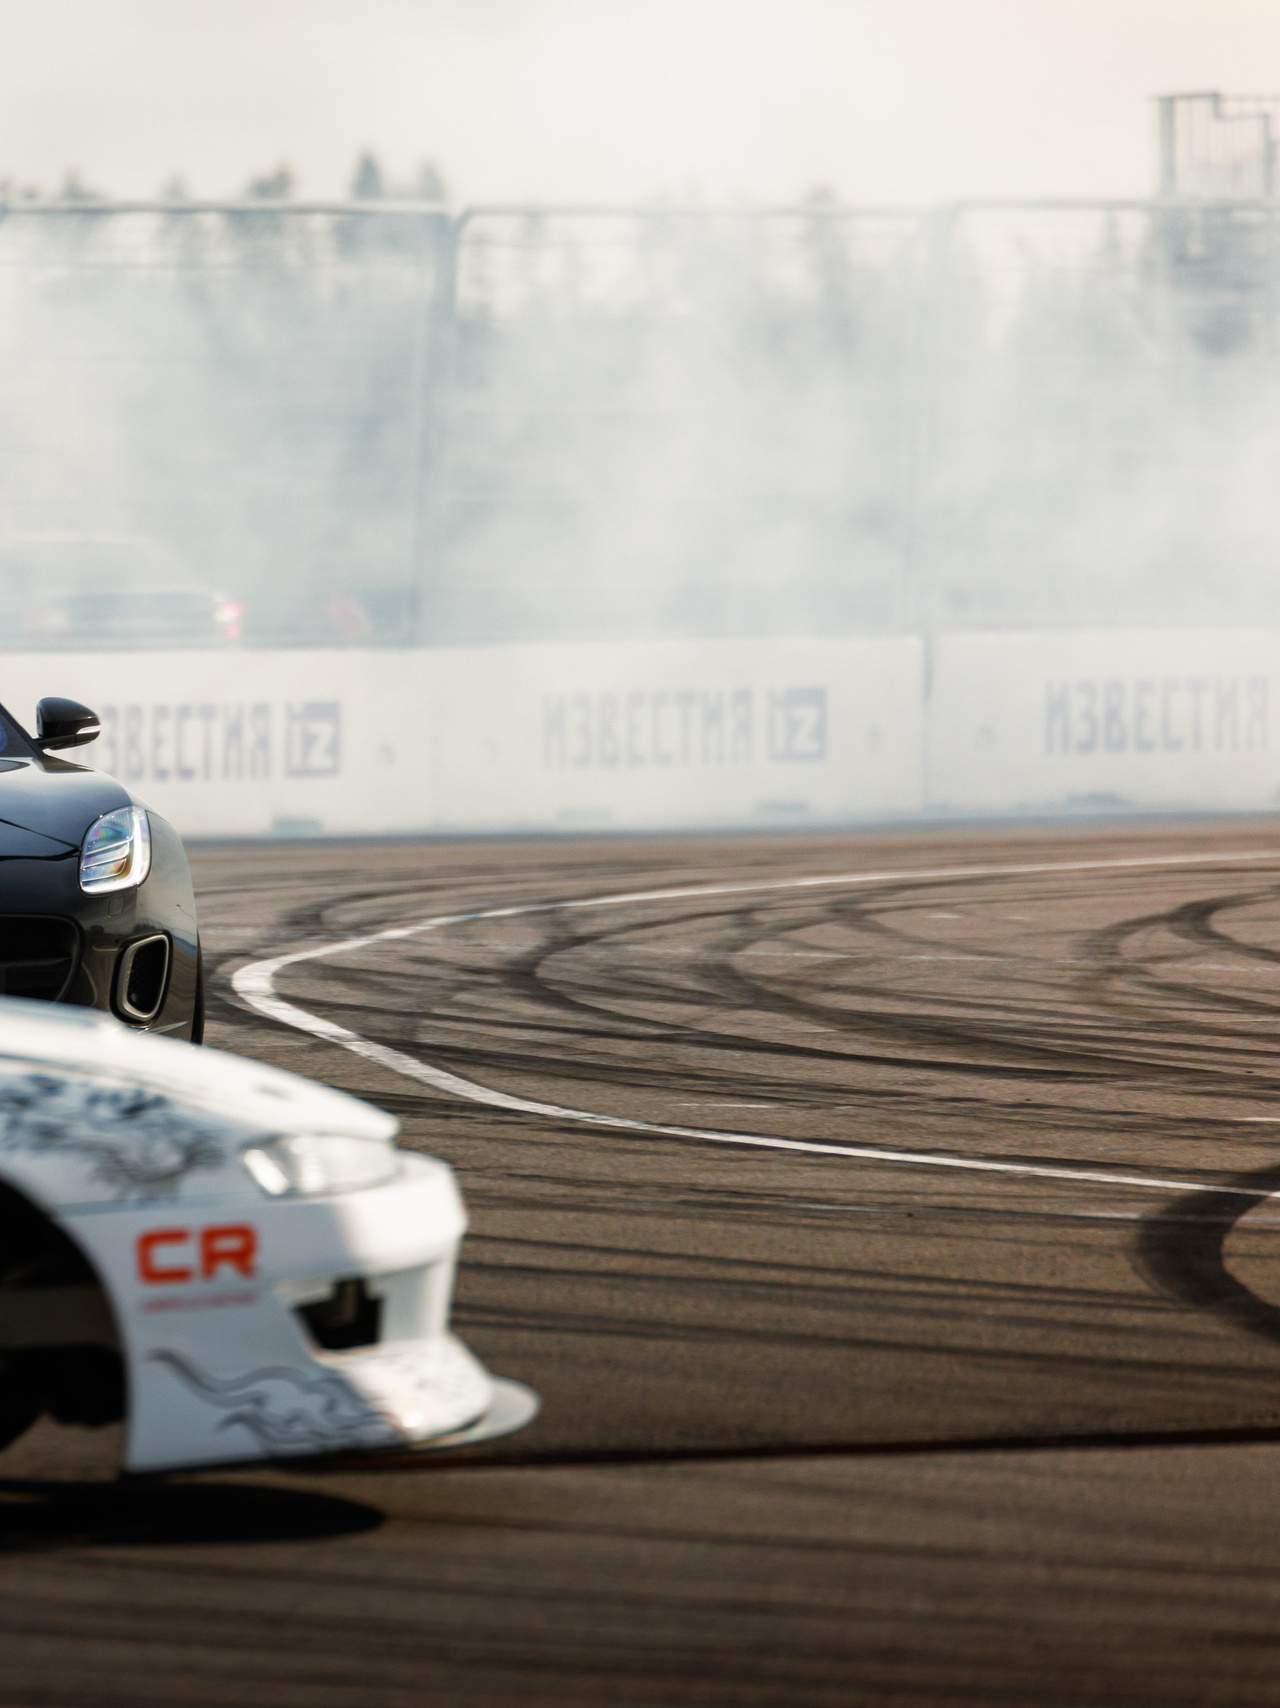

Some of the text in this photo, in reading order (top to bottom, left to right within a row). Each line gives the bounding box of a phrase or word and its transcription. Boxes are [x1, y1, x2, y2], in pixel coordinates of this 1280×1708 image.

[542, 688, 752, 769] ИЗВЕСТИЯ
[1045, 677, 1268, 754] ИЗВЕСТИЯ
[136, 1224, 258, 1284] CR
